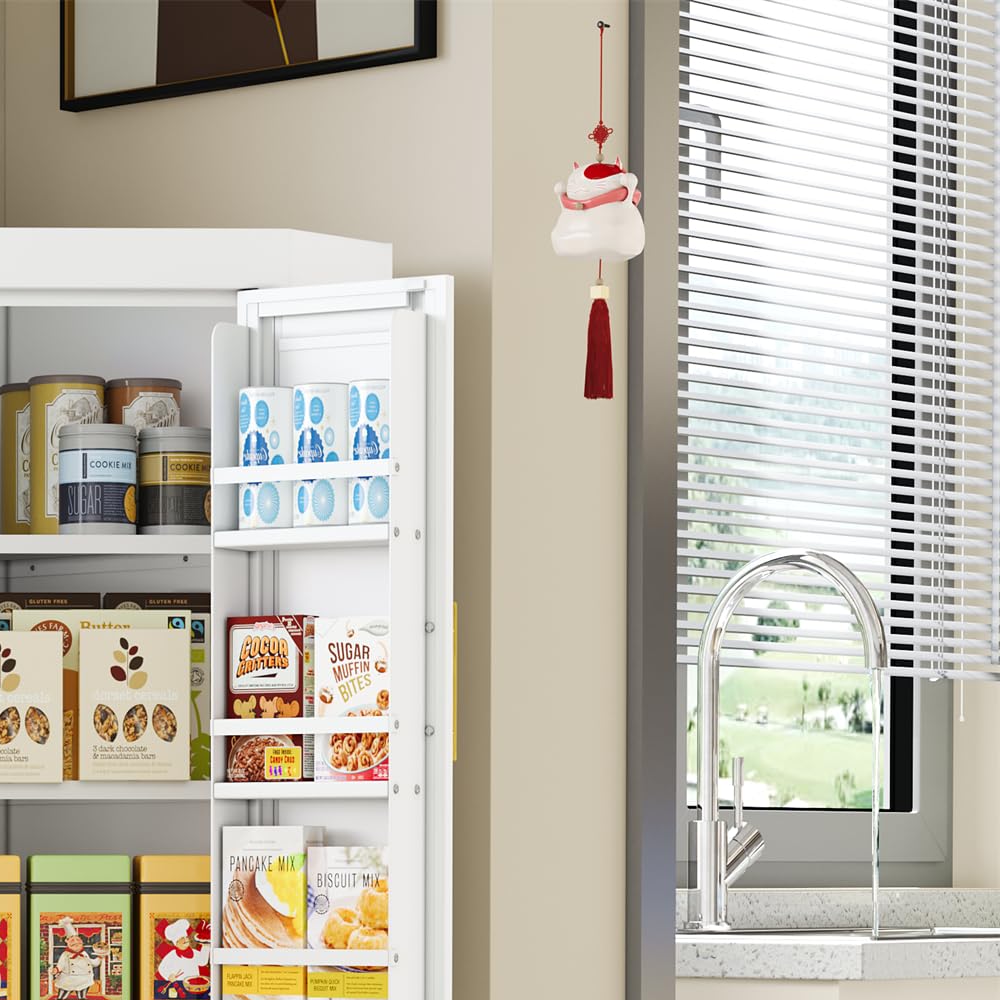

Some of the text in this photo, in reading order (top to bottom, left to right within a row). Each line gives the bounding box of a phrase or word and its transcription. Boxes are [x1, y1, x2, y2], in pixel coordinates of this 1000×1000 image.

[89, 460, 132, 470] COOKIE MIX
[169, 463, 201, 472] COOKIE
[67, 485, 102, 516] SUGAR
[239, 635, 289, 662] COCOA
[328, 642, 370, 663] SUGAR
[236, 656, 289, 678] CRITTERS
[332, 661, 370, 683] MUFFIN
[338, 673, 372, 703] BITES
[229, 855, 296, 872] PANCAKE MIX
[317, 873, 380, 888] BISCUIT MIX
